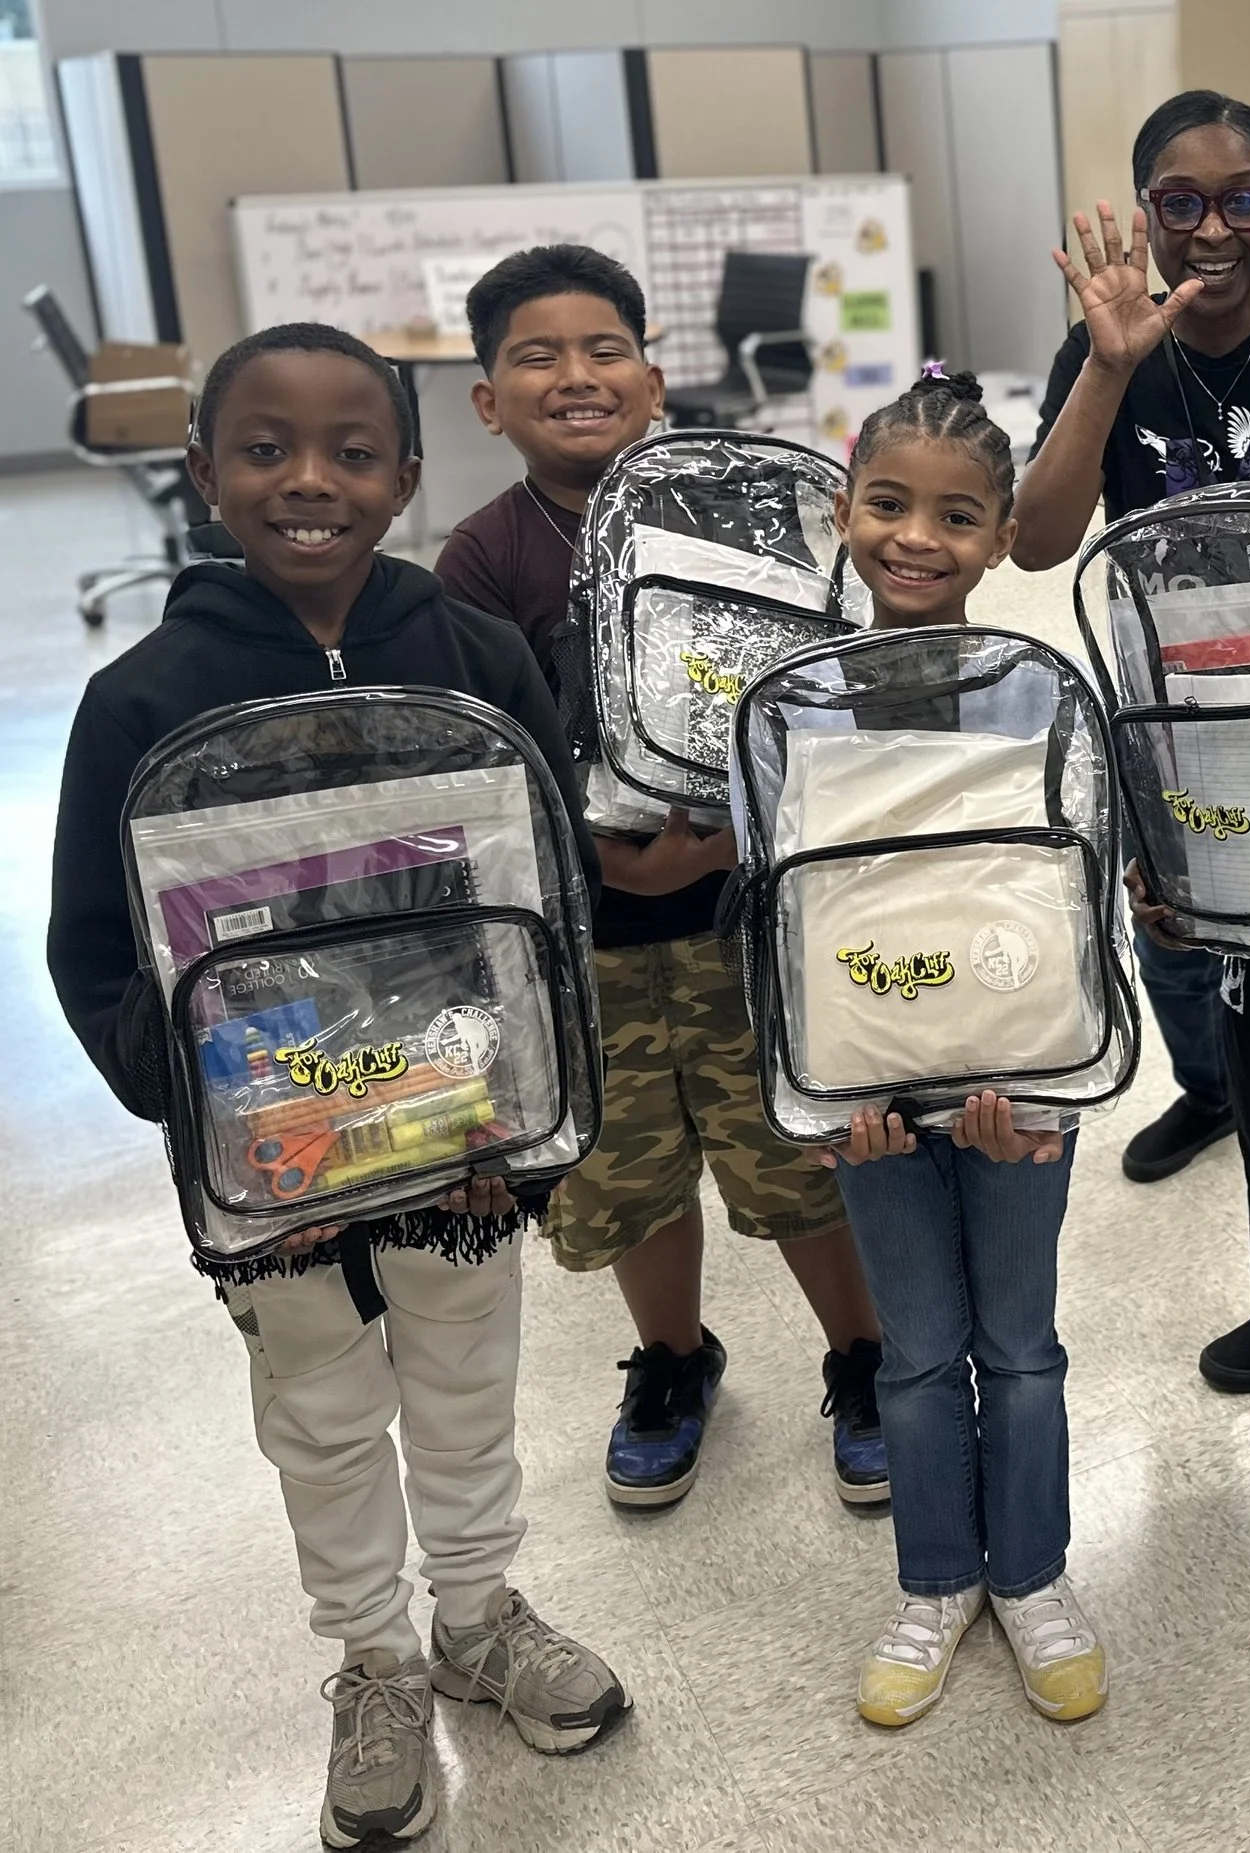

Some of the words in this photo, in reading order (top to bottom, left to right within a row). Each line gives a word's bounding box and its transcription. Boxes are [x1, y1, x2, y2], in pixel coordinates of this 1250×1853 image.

[1162, 786, 1195, 825] For
[837, 940, 881, 985] For
[229, 973, 286, 995] COLLEGE
[427, 1009, 455, 1056] KERSHAW'S
[460, 1008, 499, 1042] CHALLENGE
[444, 1043, 462, 1058] KC
[273, 1037, 325, 1088] For
[453, 1051, 469, 1065] 22
